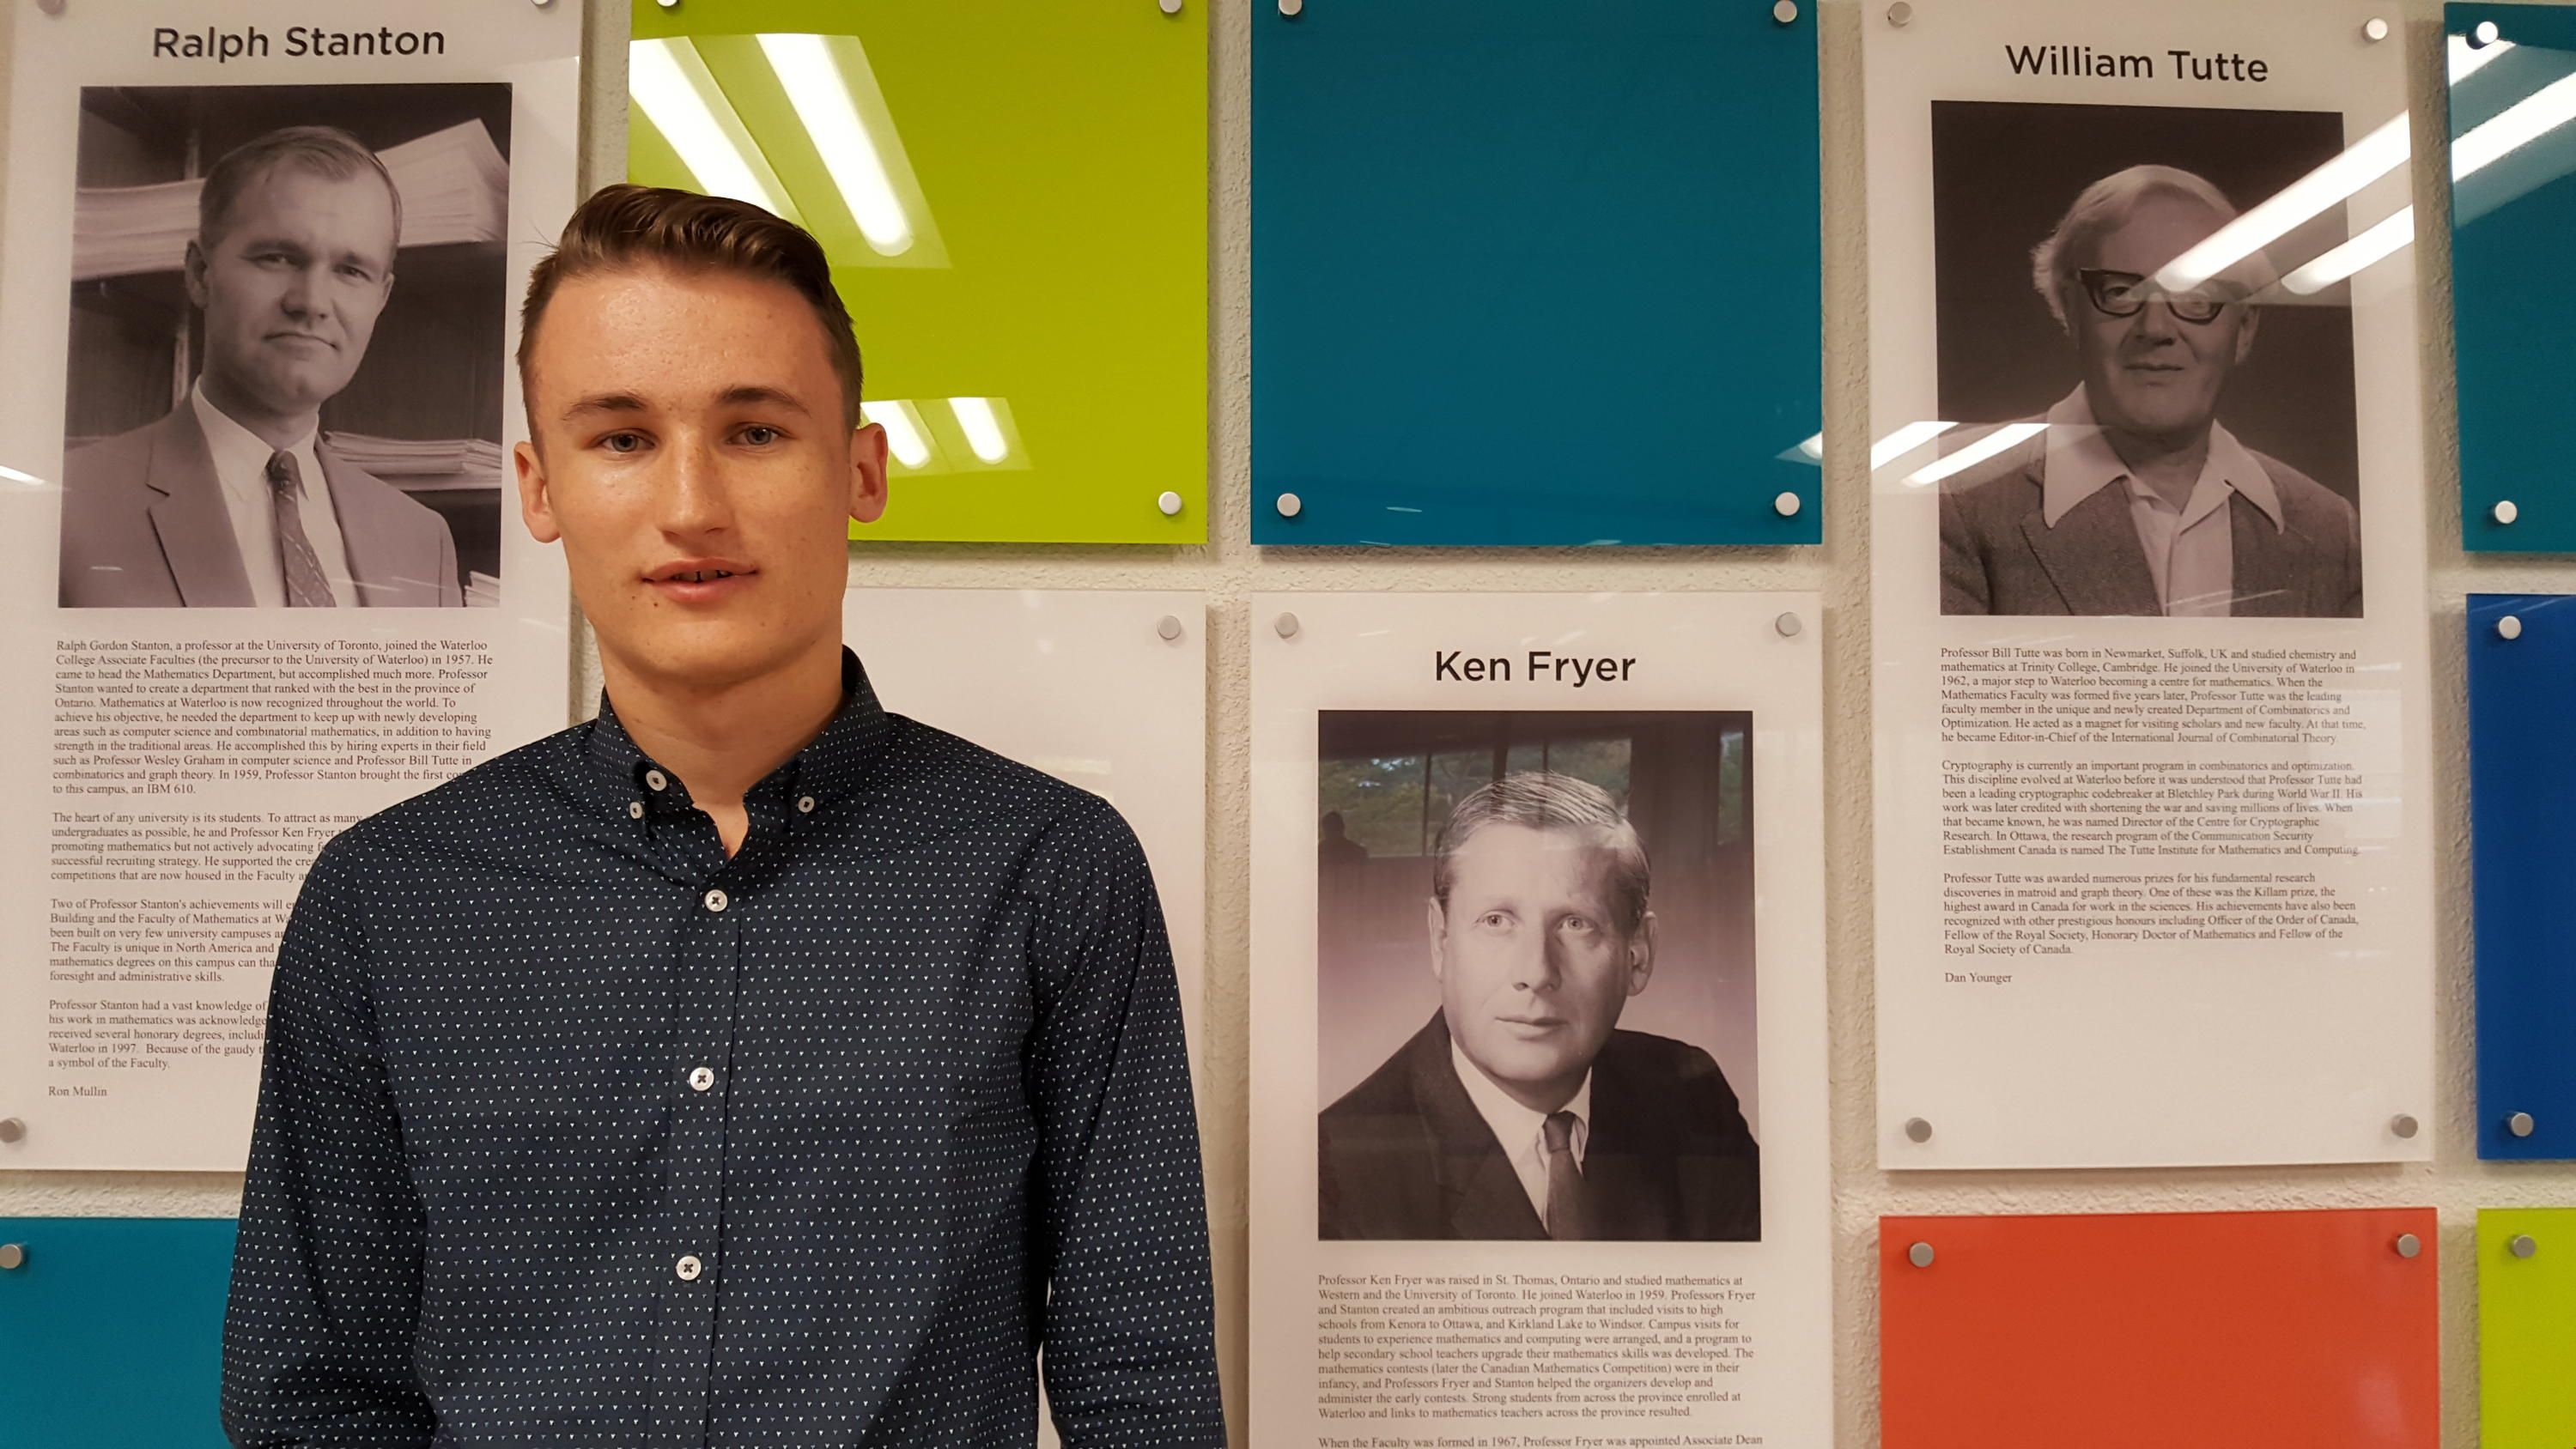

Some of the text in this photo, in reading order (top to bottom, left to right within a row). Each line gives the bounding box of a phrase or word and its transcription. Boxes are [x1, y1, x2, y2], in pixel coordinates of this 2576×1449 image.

[154, 27, 444, 64] Ralph Stanton
[2005, 45, 2268, 82] William Tutte
[56, 639, 488, 653] Ralph Gordon Stanton, a professor at the University of Toronto, joined the Waterloo
[55, 652, 494, 668] College Associate Faculties (the precursor to the University of Waterloo) in 1957. He
[1940, 646, 2357, 663] Professor Bill Tutte was born in Newmarket, Suffolk, UK and studied chemistry and
[54, 668, 489, 682] came to head the Mathematics Department, but accomplished much more. Professor
[1436, 651, 1636, 688] Ken Fryer
[1941, 731, 1954, 743] he
[1956, 731, 1996, 743] became
[1998, 731, 2077, 743] Editor-in-Chief
[2078, 731, 2090, 743] of
[2092, 731, 2109, 743] the
[2111, 731, 2175, 743] International
[2177, 731, 2214, 743] Journal
[2215, 731, 2227, 743] of
[2228, 731, 2300, 743] Combinatorial
[1943, 773, 2362, 788] This discipline evolved at Waterloo before it was understood that Professor Tutte had
[52, 782, 197, 797] to this campus, an IBM 610.
[52, 898, 74, 909] Two
[75, 898, 87, 909] of
[88, 898, 138, 910] Professor
[139, 898, 187, 910] Stanton's
[188, 898, 260, 910] achievements
[262, 898, 283, 911] will
[1944, 943, 1975, 957] Royal
[1978, 943, 2017, 957] Society
[2019, 943, 2030, 955] of
[49, 969, 225, 985] foresight and administrative skills.
[1944, 972, 2013, 985] Dan Younger
[47, 1056, 170, 1071] a symbol of the Faculty.
[47, 1085, 107, 1097] Ron Mullin
[1318, 1273, 1367, 1286] Professor
[1370, 1274, 1392, 1286] Ken
[1394, 1274, 1423, 1288] Fryer
[1425, 1276, 1446, 1285] was
[1448, 1274, 1479, 1286] raised
[1482, 1273, 1493, 1286] in
[1513, 1274, 1558, 1287] Thomas,
[1559, 1274, 1601, 1286] Ontario
[1602, 1274, 1622, 1286] and
[1624, 1274, 1663, 1286] studied
[1664, 1274, 1731, 1287] mathematics
[1732, 1276, 1743, 1286] at
[1318, 1288, 1360, 1300] Western
[1362, 1288, 1382, 1300] and
[1384, 1288, 1401, 1300] the
[1403, 1288, 1458, 1303] University
[1461, 1288, 1472, 1300] of
[1522, 1288, 1538, 1300] He
[1538, 1288, 1573, 1303] joined
[1576, 1288, 1623, 1300] Waterloo
[1625, 1288, 1636, 1300] in
[1639, 1288, 1668, 1300] 1959.
[1670, 1288, 1725, 1301] Professors
[1727, 1288, 1756, 1303] Fryer
[1318, 1406, 1366, 1419] Waterloo
[1368, 1407, 1388, 1419] and
[1390, 1406, 1416, 1419] links
[1418, 1408, 1430, 1419] to
[1431, 1406, 1498, 1419] mathematics
[1499, 1406, 1544, 1418] teachers
[1545, 1409, 1579, 1418] across
[1581, 1406, 1598, 1418] the
[1600, 1409, 1646, 1421] province
[1317, 1434, 1763, 1449] When the Faculty was formed in 1967, Professor Fryer was appointed Associate Dean
